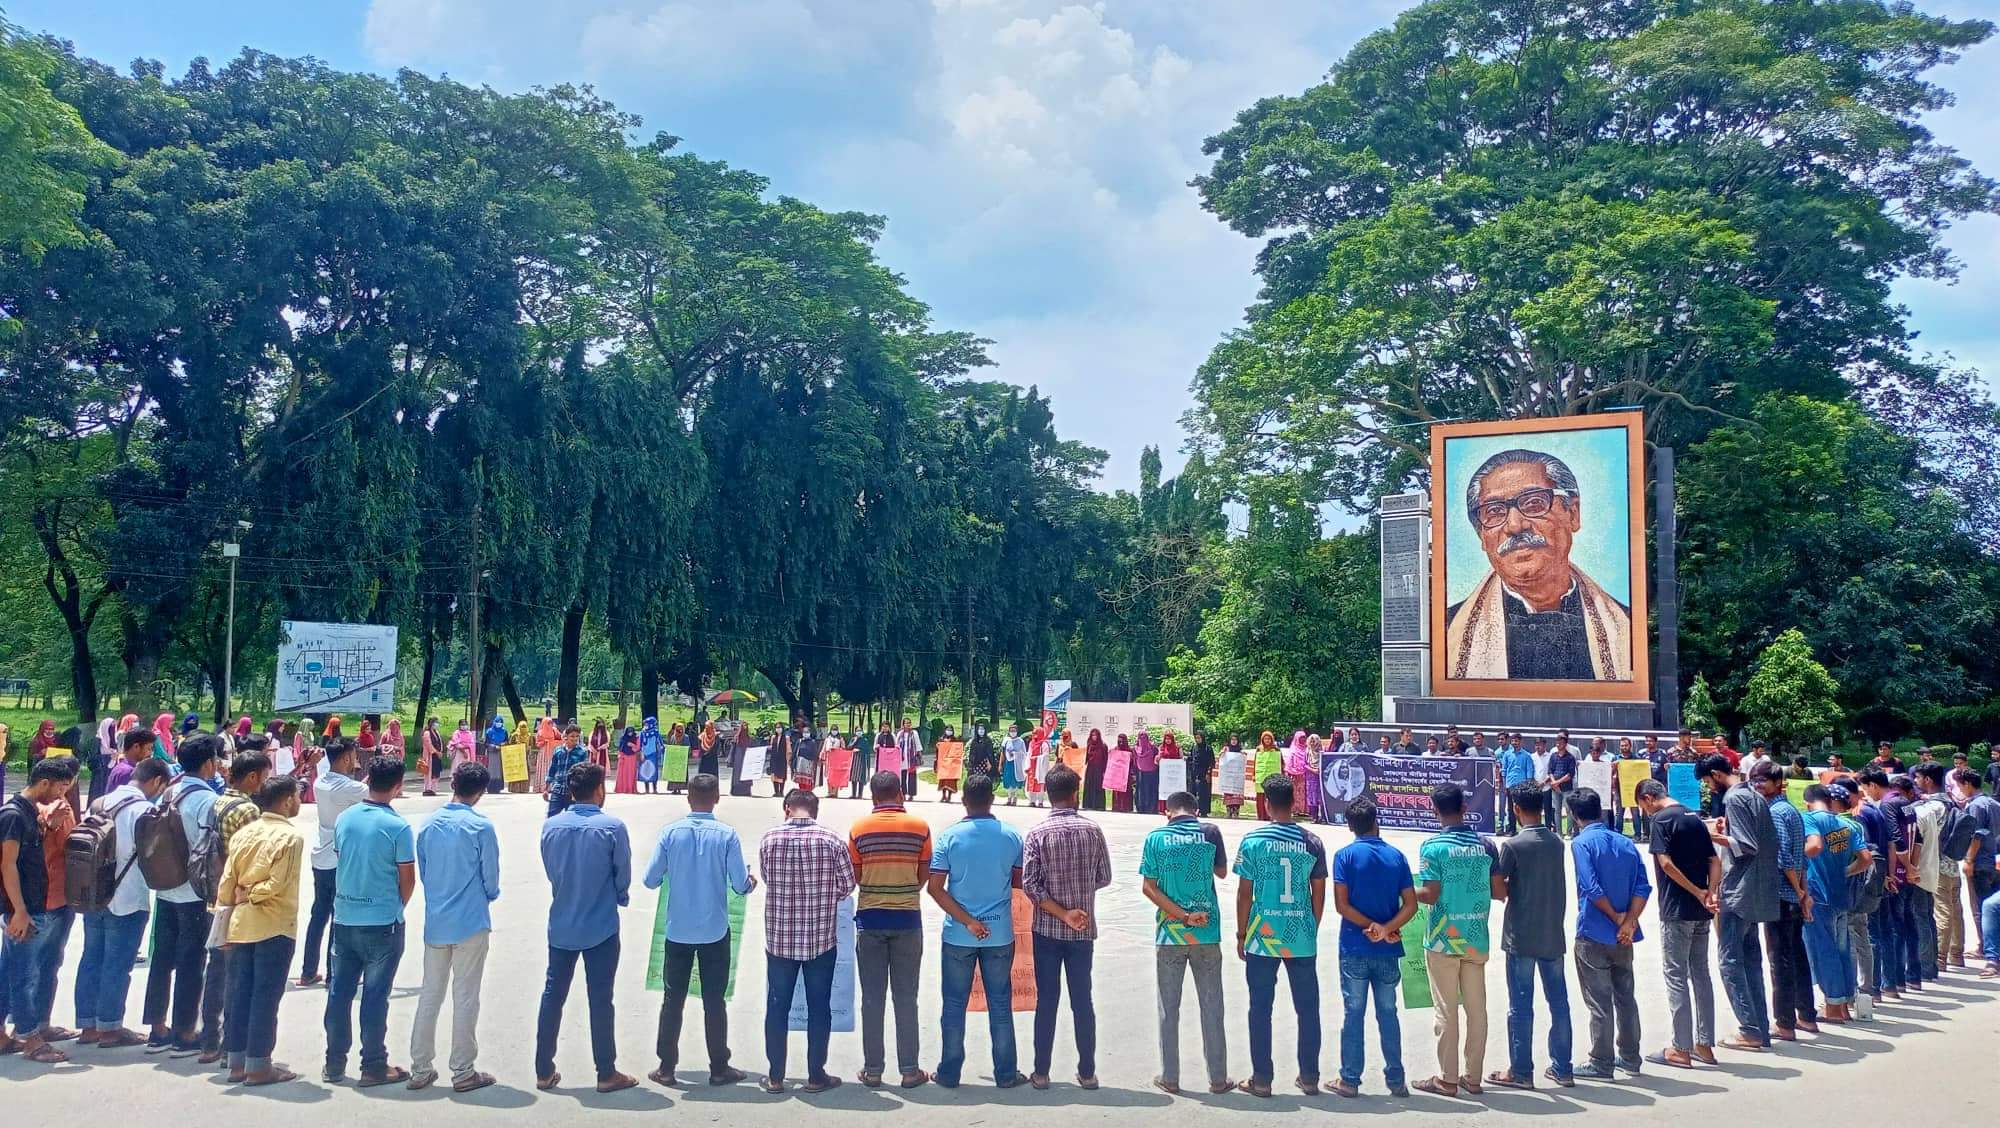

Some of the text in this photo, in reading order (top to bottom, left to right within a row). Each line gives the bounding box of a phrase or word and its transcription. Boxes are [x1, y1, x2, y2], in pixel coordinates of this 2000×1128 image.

[1407, 760, 1458, 772] শোকাহত
[1265, 840, 1310, 855] PORIMOL
[1279, 857, 1295, 904] 1
